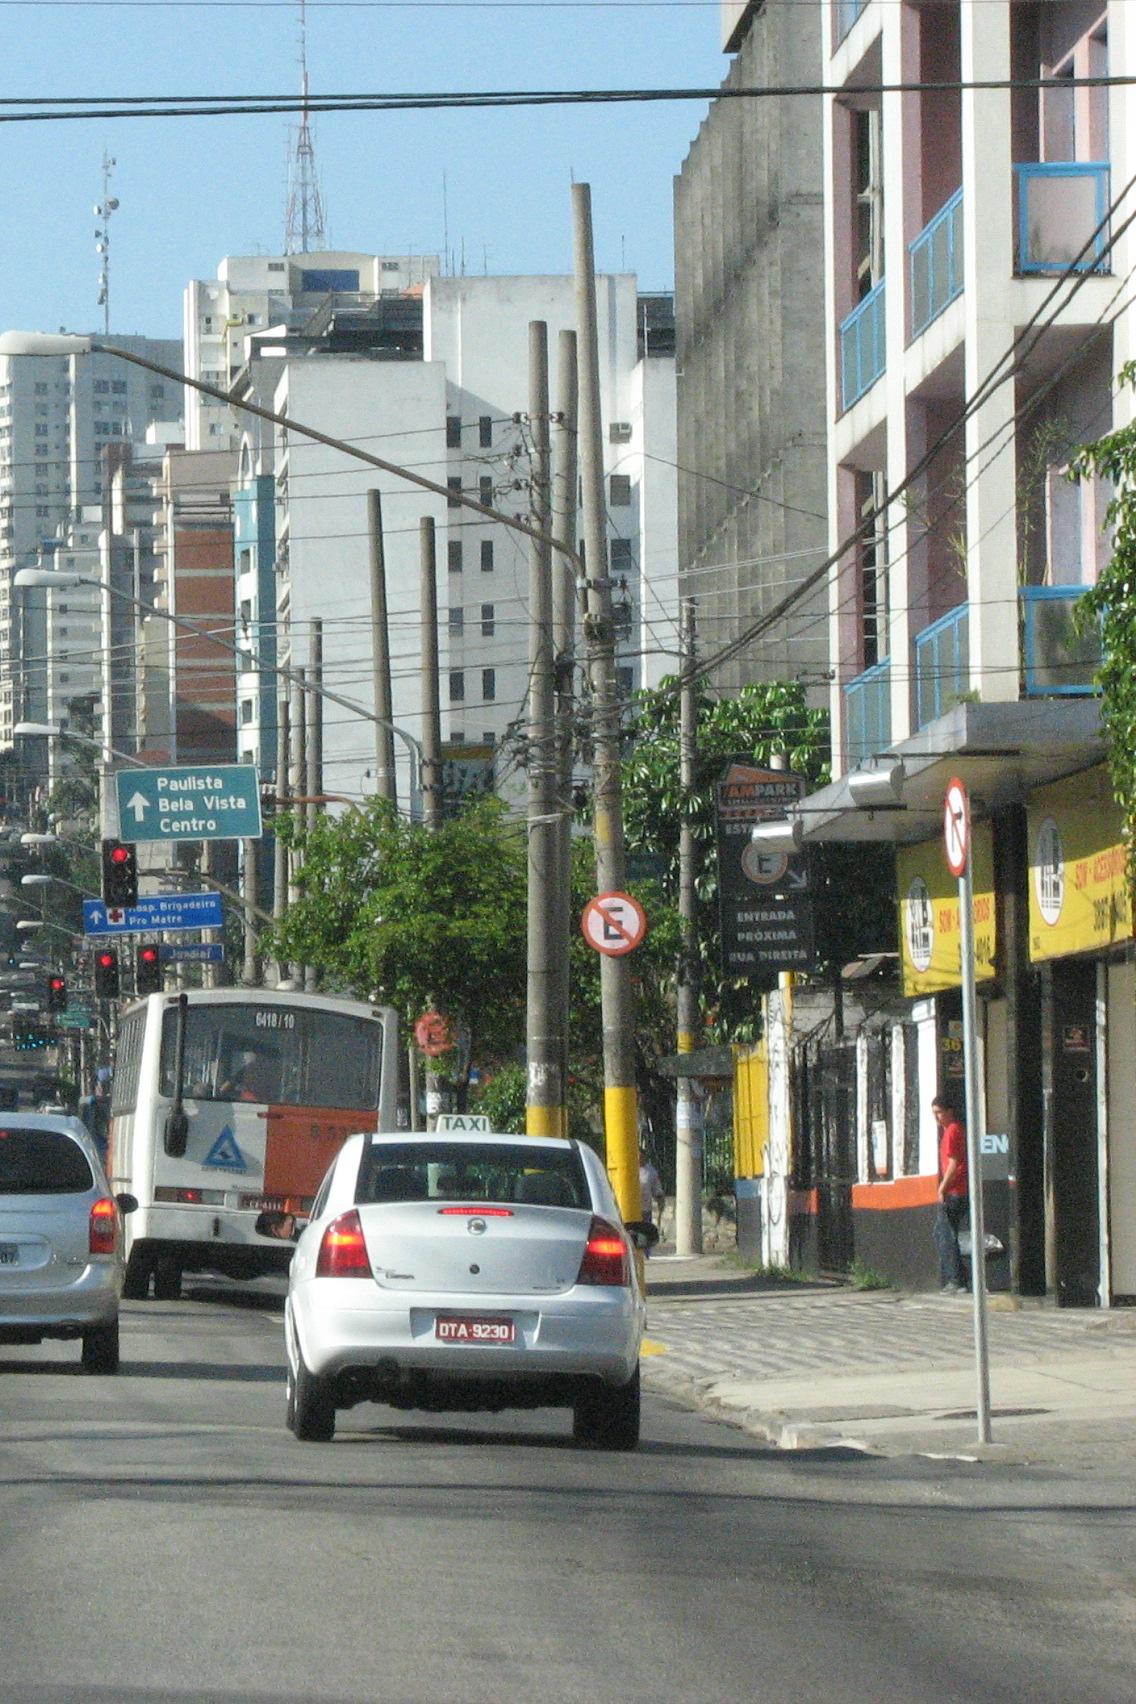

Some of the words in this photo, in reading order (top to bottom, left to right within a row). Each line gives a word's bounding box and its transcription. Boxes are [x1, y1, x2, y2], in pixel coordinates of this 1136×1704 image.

[156, 775, 224, 792] Paulista
[158, 797, 194, 813] Bela
[202, 795, 247, 811] Vista
[159, 818, 217, 833] Centro
[159, 900, 217, 912] Brigadeiro
[128, 916, 148, 926] Pro
[737, 910, 797, 922] ENTRADA
[737, 929, 798, 942] PRÓXIMA
[758, 949, 808, 961] DIREITA
[442, 1115, 487, 1132] TAXI
